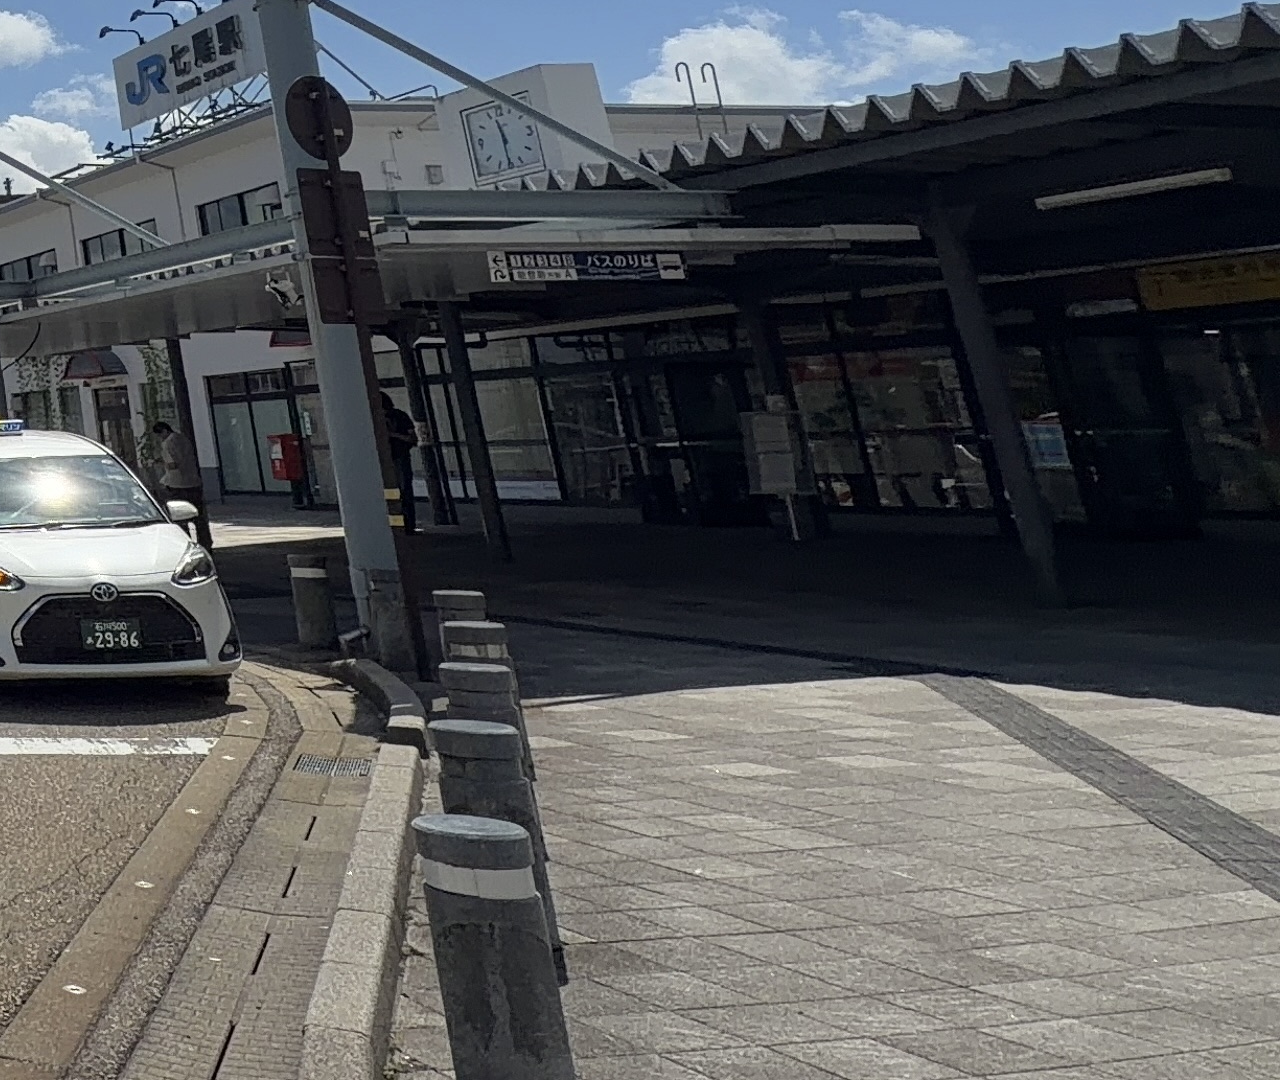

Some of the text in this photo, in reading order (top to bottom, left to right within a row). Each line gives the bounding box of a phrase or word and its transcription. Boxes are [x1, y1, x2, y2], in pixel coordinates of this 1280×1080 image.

[125, 54, 170, 106] JR
[525, 125, 534, 136] 3
[478, 138, 484, 150] 9
[587, 254, 655, 268] バスのりば
[95, 631, 139, 648] 29-86
